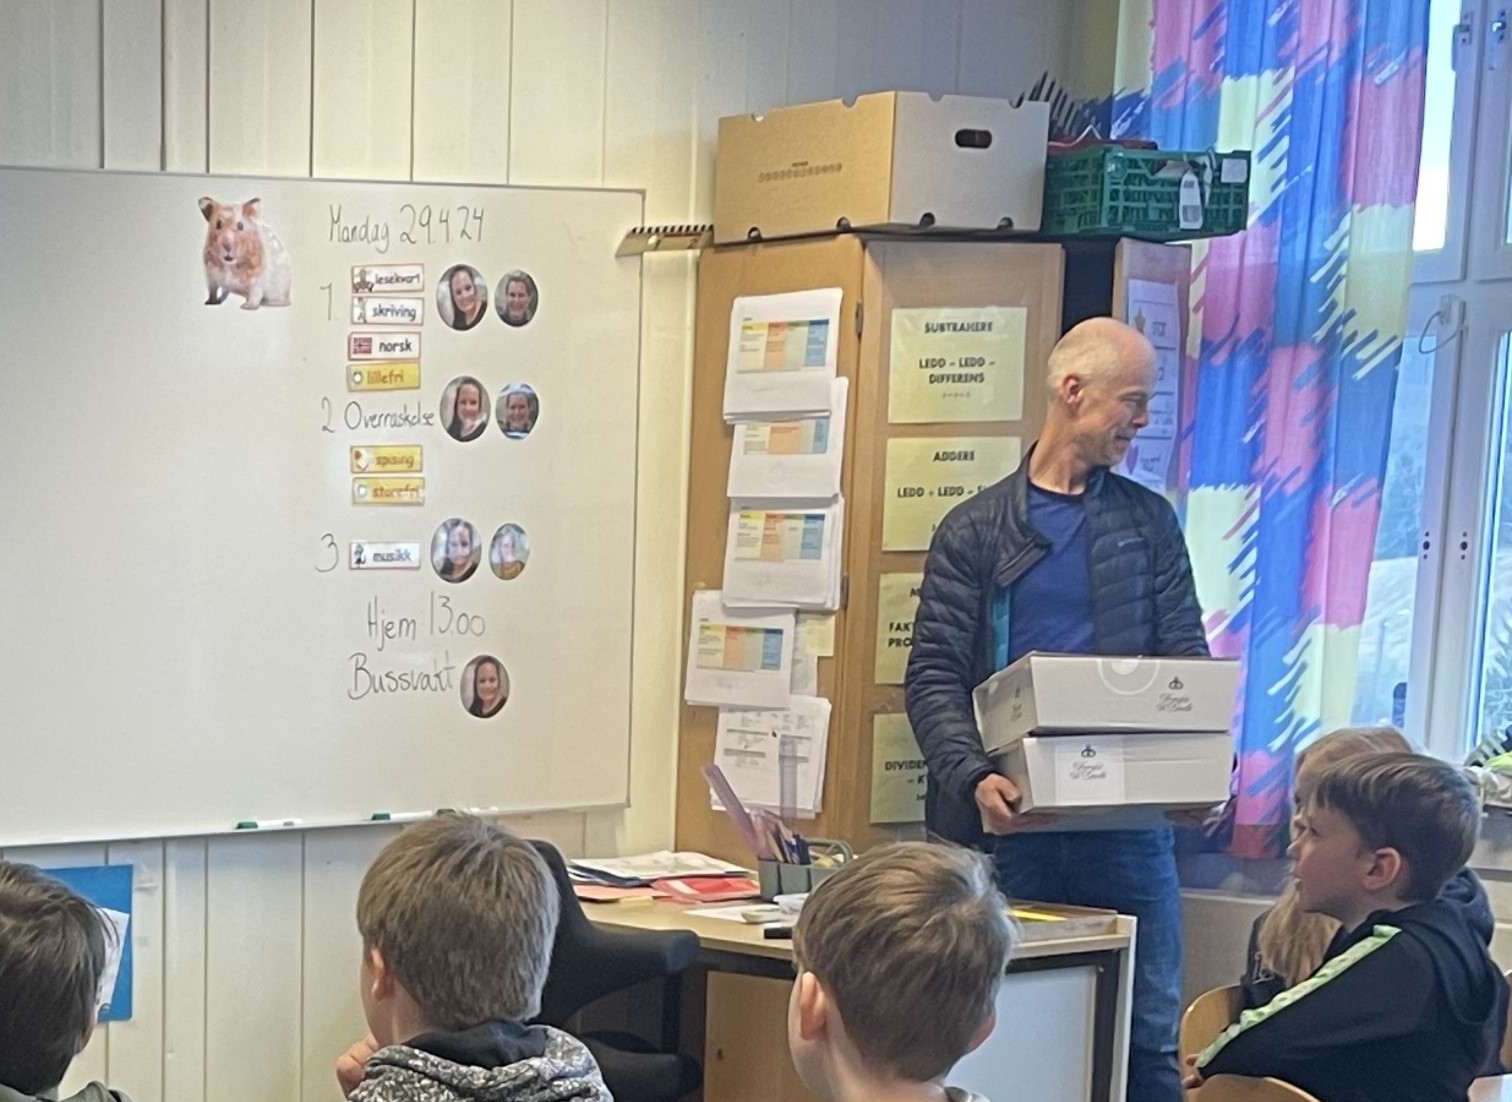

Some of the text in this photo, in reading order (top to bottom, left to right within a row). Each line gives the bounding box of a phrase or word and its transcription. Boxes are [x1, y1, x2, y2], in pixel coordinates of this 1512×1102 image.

[328, 203, 390, 254] Mandag
[372, 303, 417, 321] skriving
[924, 321, 993, 334] SUBTRAHERE
[378, 339, 413, 353] norsk
[919, 357, 946, 369] LEDD
[958, 356, 986, 368] LEDD
[928, 371, 985, 384] DIFFERENS
[933, 450, 975, 462] ADDERE
[897, 486, 925, 498] LEDD
[937, 485, 965, 497] LEDD
[372, 547, 412, 562] musikk
[367, 596, 416, 651] Hjem
